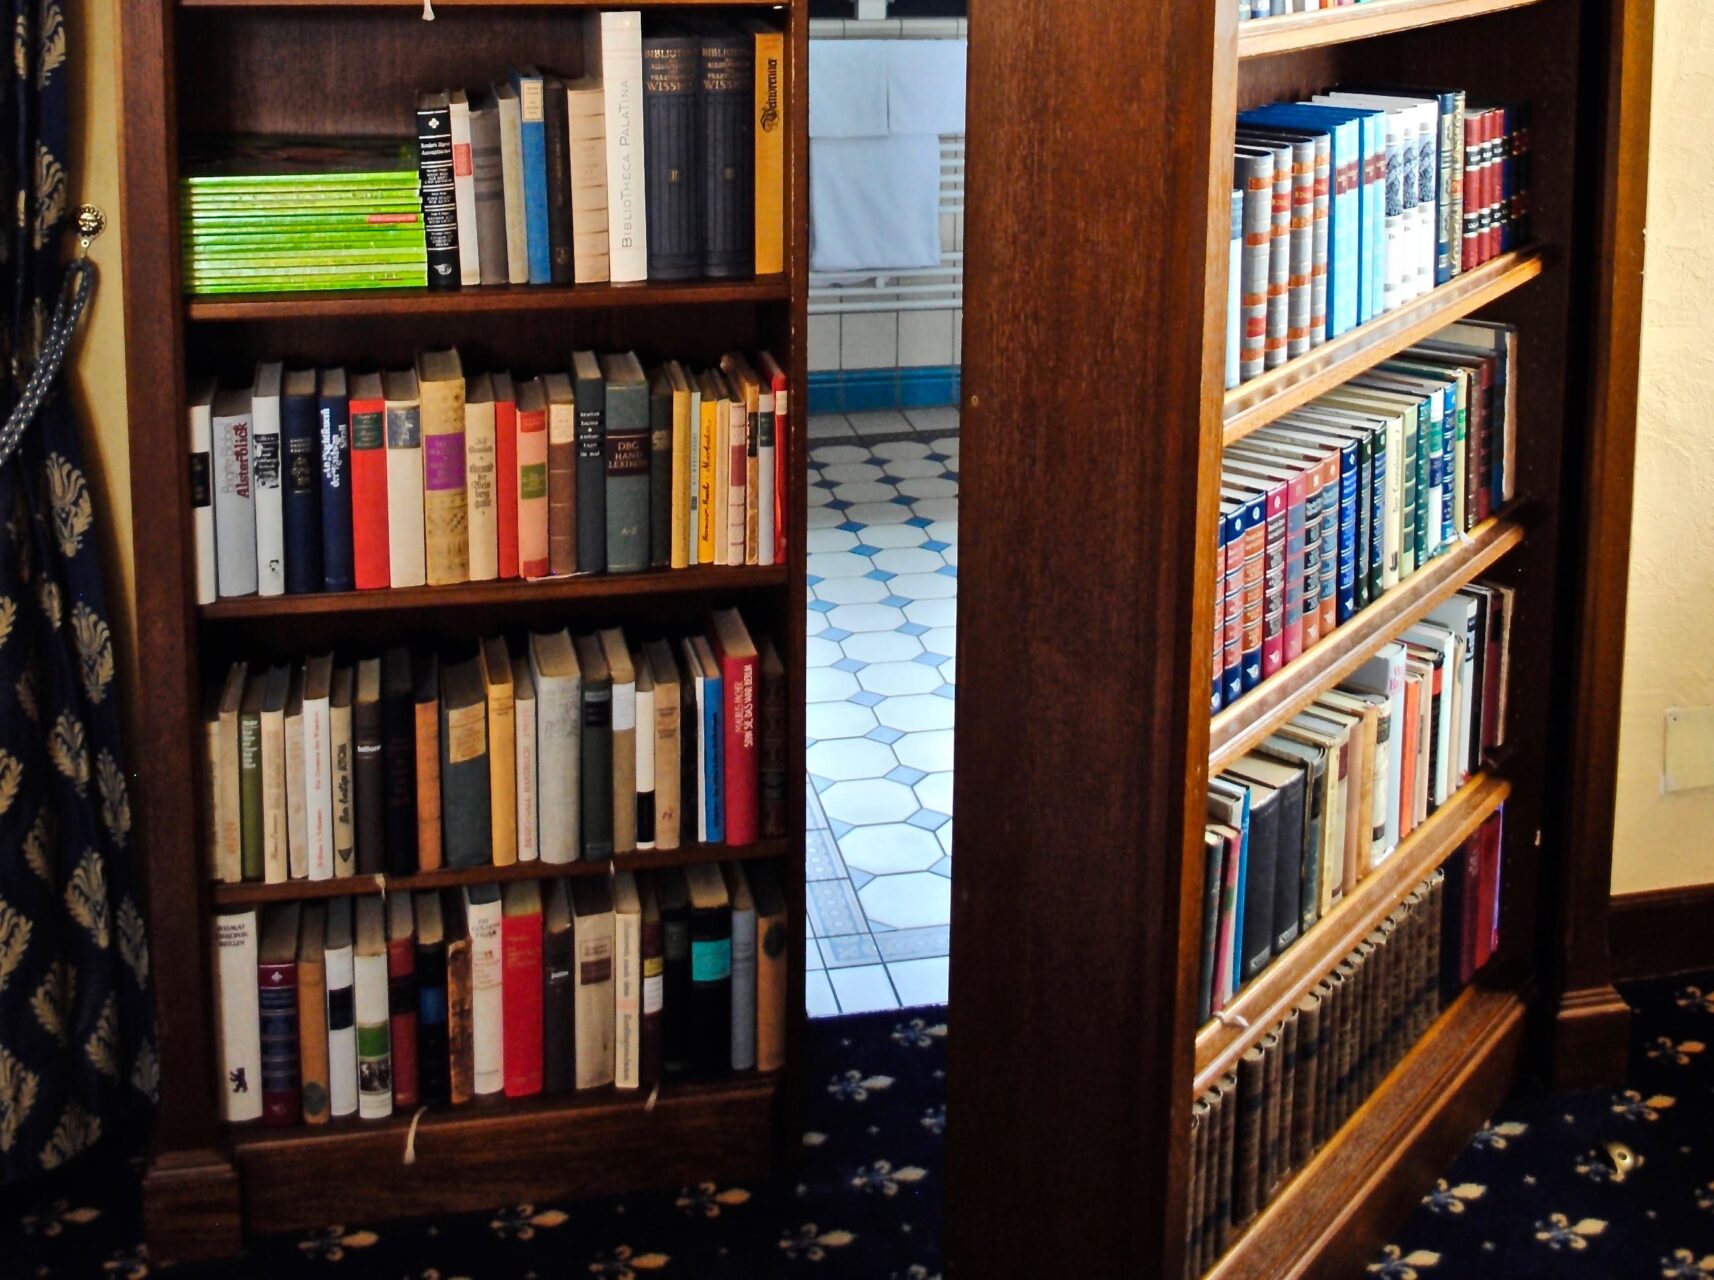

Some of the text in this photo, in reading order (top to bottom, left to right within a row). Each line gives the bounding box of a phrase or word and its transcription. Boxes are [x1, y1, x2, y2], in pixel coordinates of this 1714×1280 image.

[619, 79, 633, 249] BIBLIOTHECA PALATINA
[233, 421, 250, 500] Alsterblick
[618, 441, 639, 451] DBG
